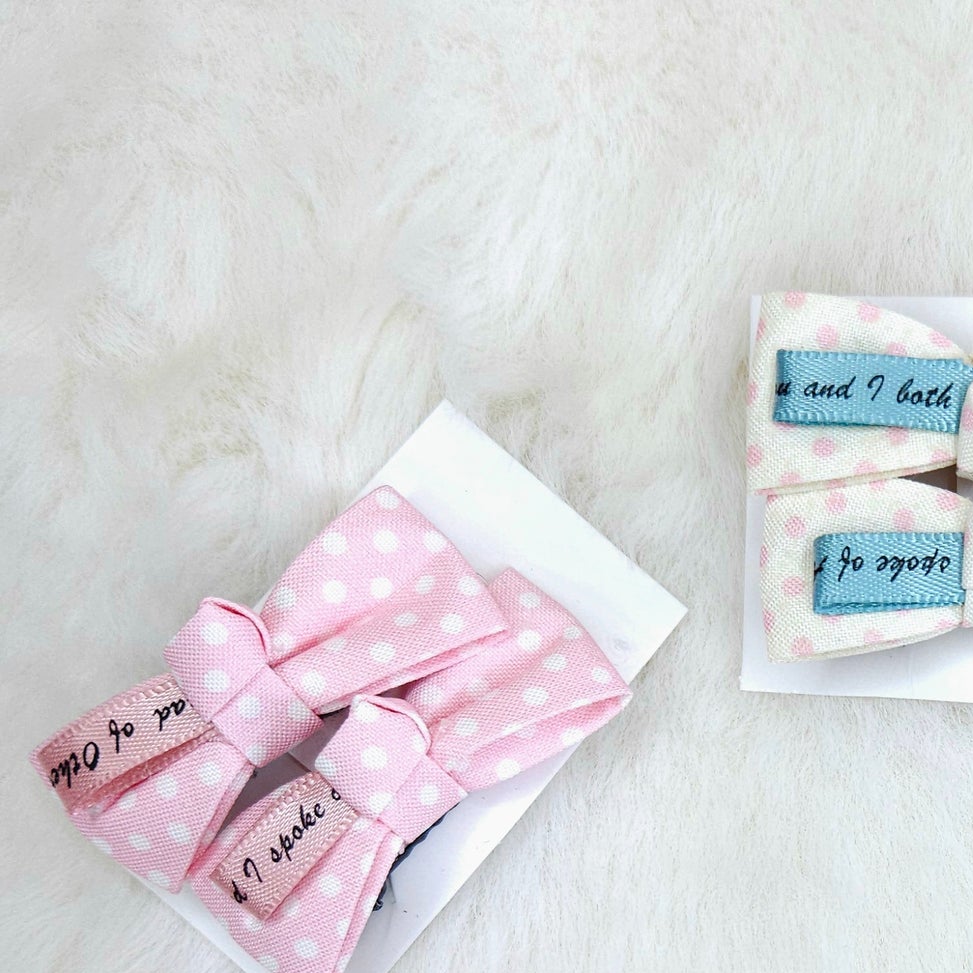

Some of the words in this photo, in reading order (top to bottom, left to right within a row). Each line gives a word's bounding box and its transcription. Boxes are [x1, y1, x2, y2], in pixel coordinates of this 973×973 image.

[803, 375, 857, 400] and
[867, 374, 885, 402] I
[896, 378, 954, 409] both
[837, 545, 865, 582] of
[875, 547, 951, 582] spoke
[108, 718, 135, 754] of
[242, 857, 263, 883] I
[269, 802, 326, 863] spoke
